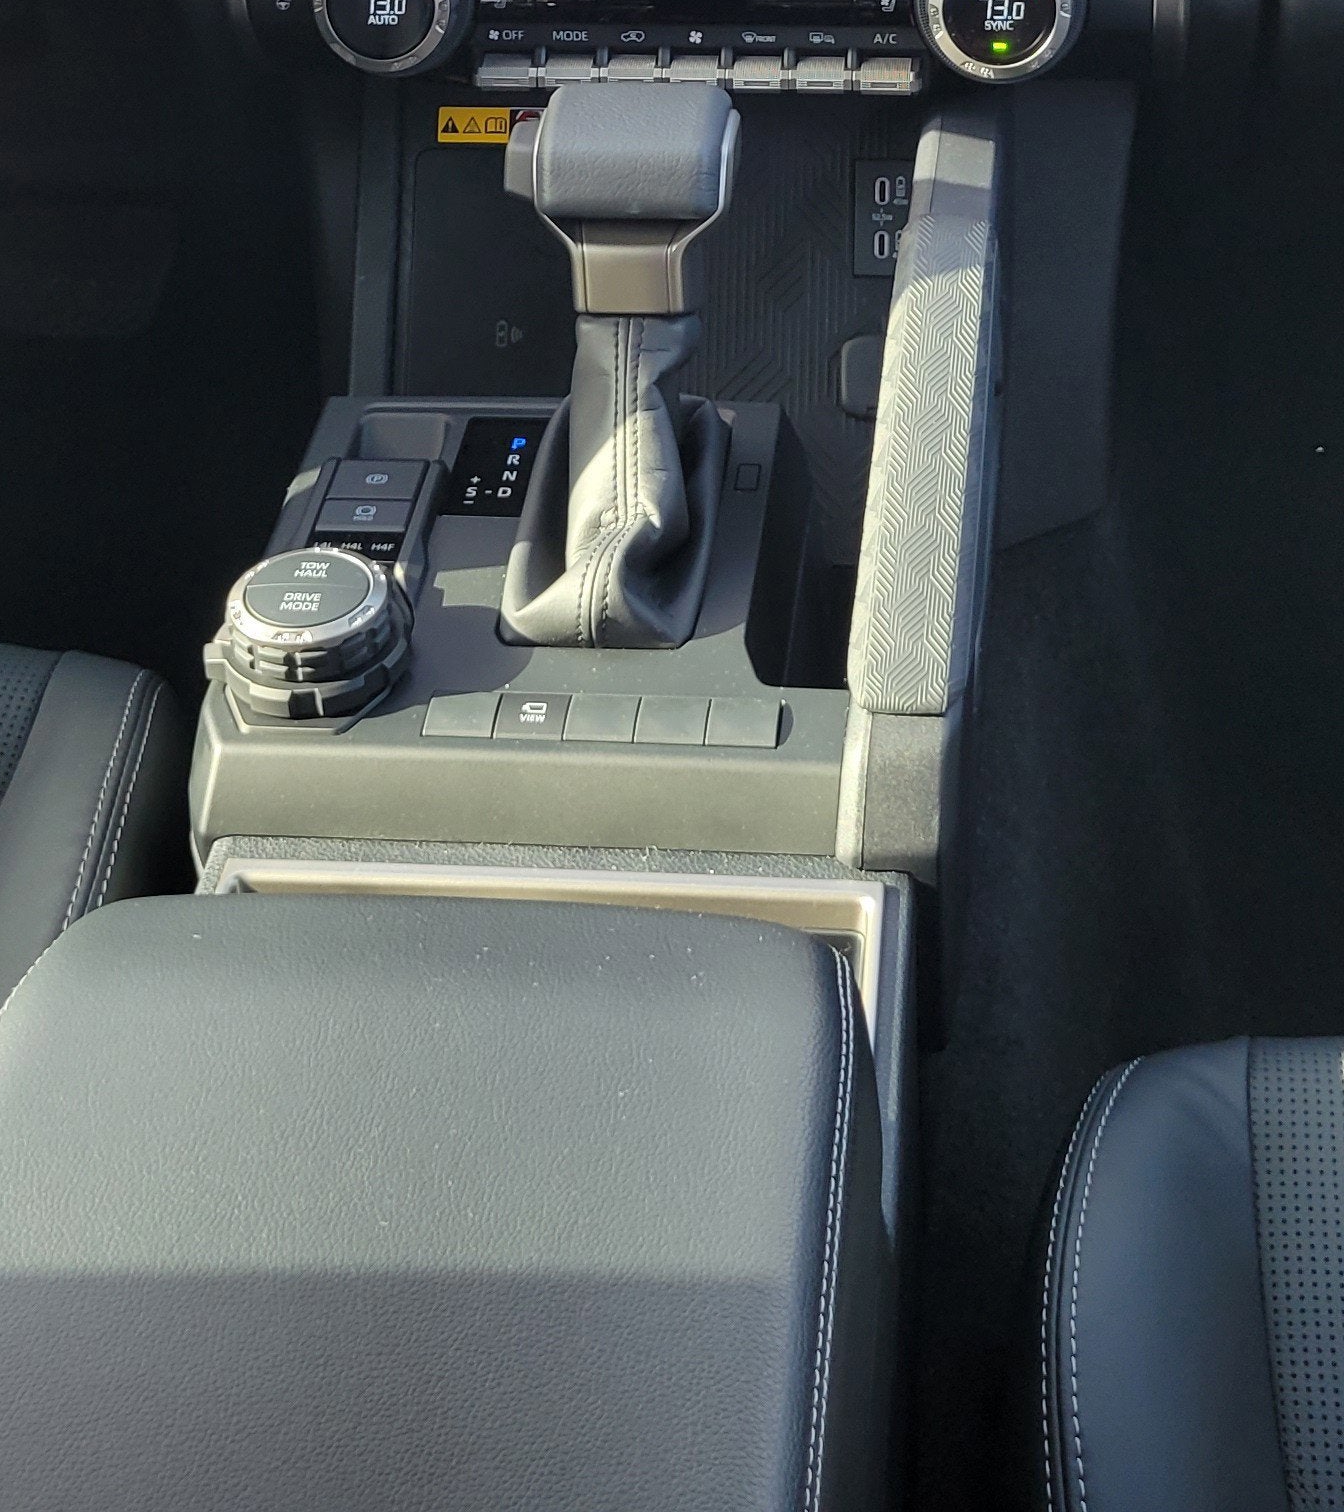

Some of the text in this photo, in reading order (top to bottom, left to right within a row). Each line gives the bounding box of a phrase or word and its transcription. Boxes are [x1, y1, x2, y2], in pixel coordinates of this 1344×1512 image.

[367, 14, 399, 26] AUTO
[983, 19, 1015, 32] SYNC
[502, 29, 525, 41] OFF
[552, 30, 589, 42] MODE
[872, 32, 898, 45] A/C
[510, 437, 527, 451] P
[506, 454, 521, 466] R
[502, 470, 518, 481] N
[465, 486, 513, 498] S D
[341, 542, 363, 551] H4L
[370, 543, 396, 552] H4F
[300, 561, 331, 570] TOW
[293, 569, 329, 579] HAUL
[283, 592, 323, 602] DRIVE
[278, 601, 321, 611] MODE
